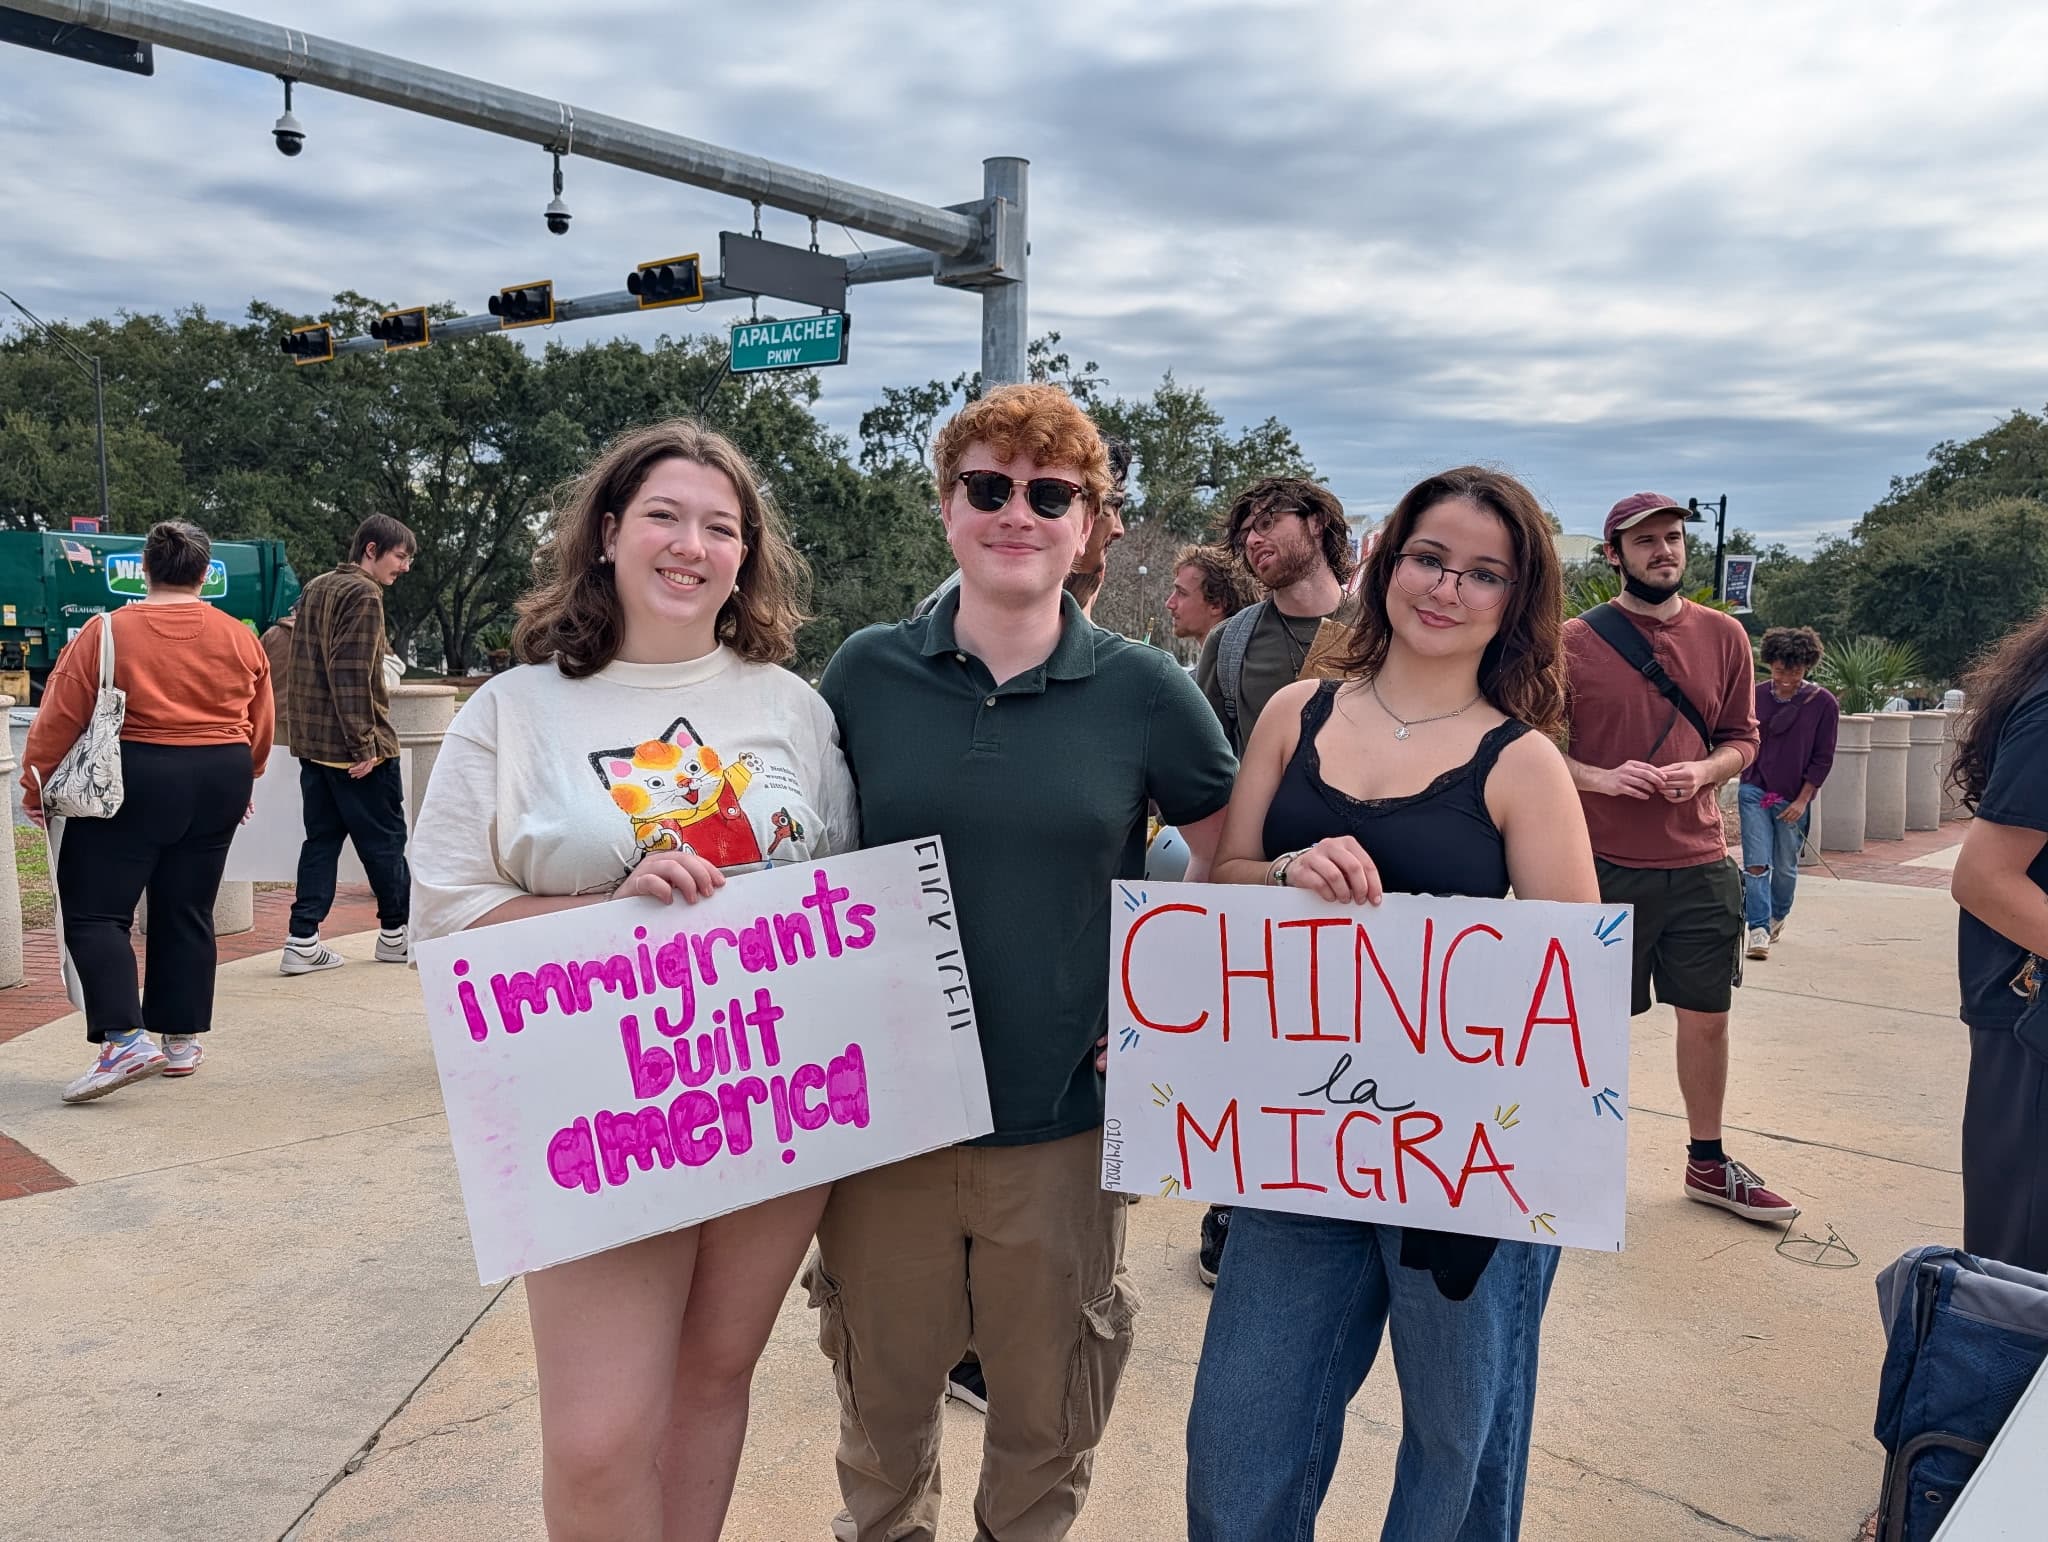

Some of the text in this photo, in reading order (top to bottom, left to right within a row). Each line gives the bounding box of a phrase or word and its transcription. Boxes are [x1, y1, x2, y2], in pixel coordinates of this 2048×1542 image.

[738, 319, 836, 347] APALACHEE
[767, 347, 801, 364] PKWY
[454, 869, 876, 1042] immigrants
[1121, 903, 1590, 1088] CHINGA
[619, 988, 785, 1100] built
[1298, 1053, 1416, 1112] la
[546, 1043, 870, 1195] america
[1103, 1118, 1125, 1190] 01/24/2026
[1177, 1098, 1529, 1215] MIGRA
